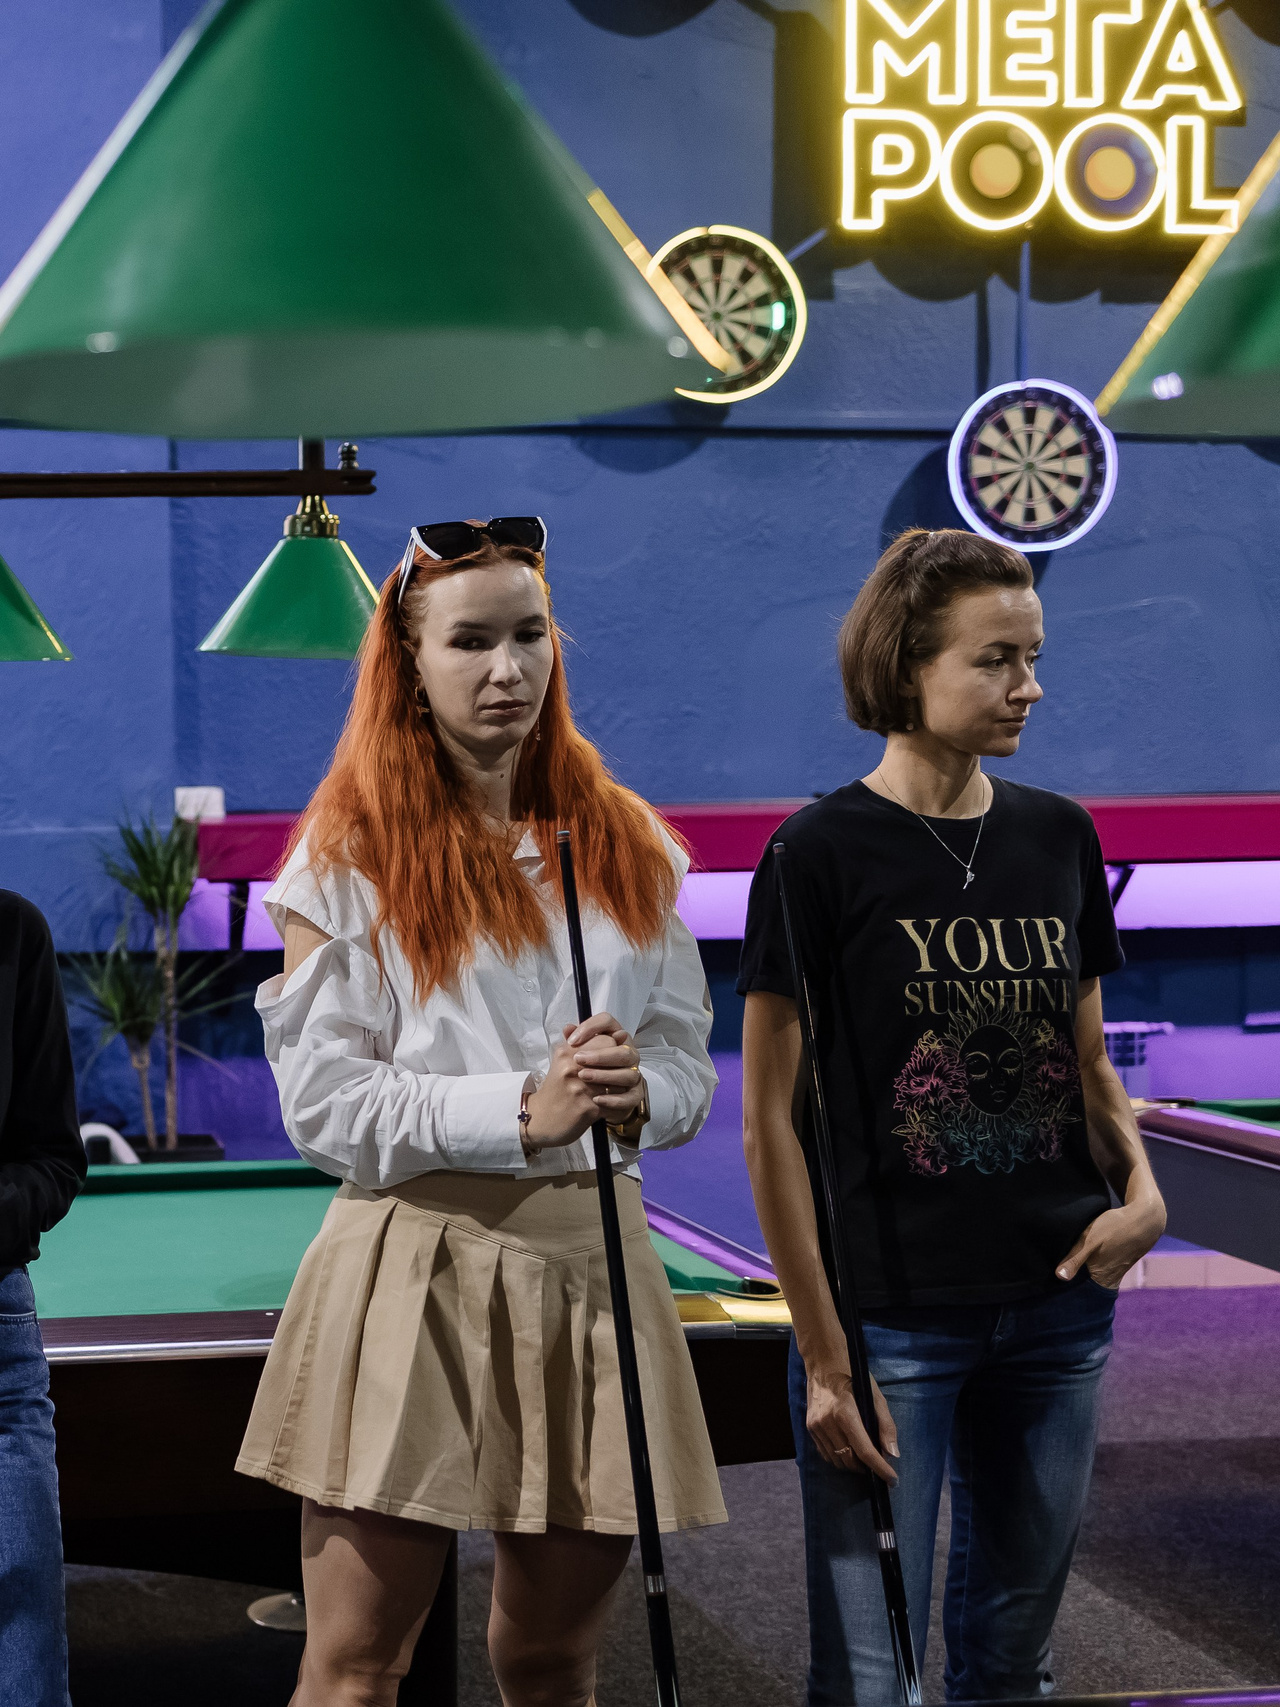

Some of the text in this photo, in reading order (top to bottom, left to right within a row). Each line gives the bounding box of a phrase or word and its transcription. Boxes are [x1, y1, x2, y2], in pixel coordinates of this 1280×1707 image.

[843, 0, 1243, 110] МЕГА
[841, 107, 1240, 234] POOL
[895, 916, 1072, 973] YOUR
